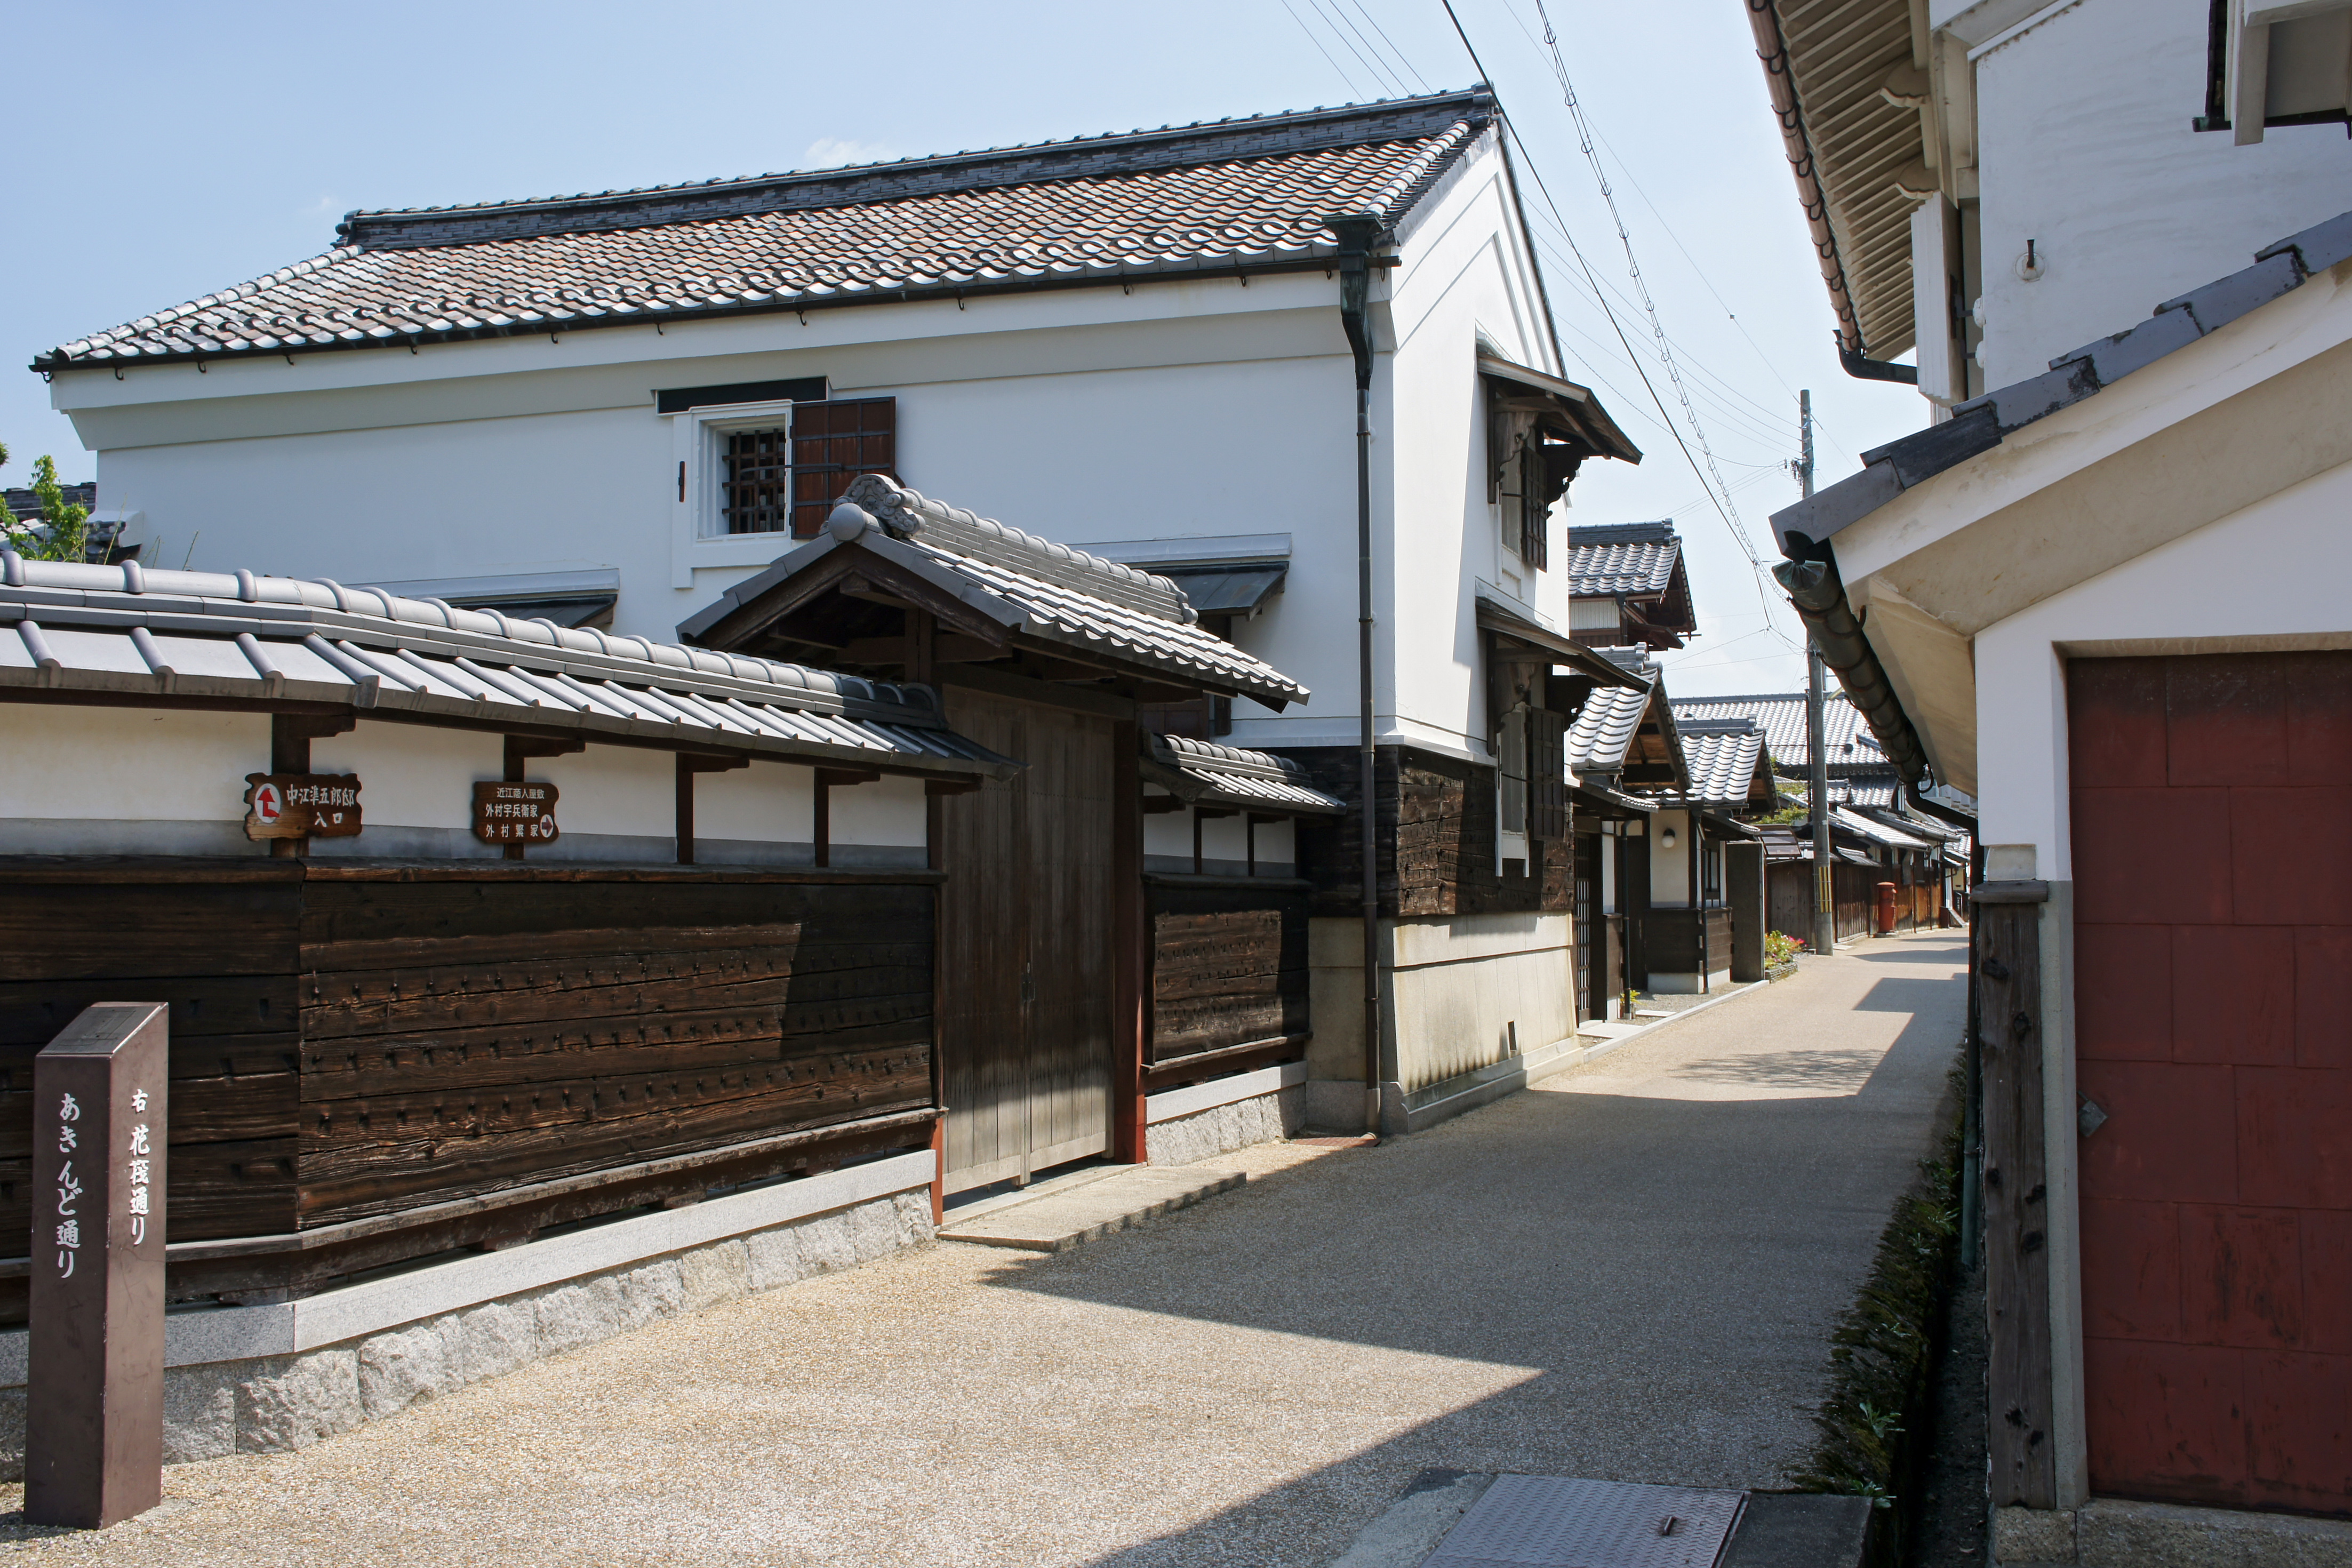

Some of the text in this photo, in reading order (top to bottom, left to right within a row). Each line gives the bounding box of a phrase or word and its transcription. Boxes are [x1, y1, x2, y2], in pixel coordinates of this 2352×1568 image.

[286, 783, 354, 807] 中江準五郎邸
[497, 787, 545, 799] 近江商人屋敷
[485, 803, 538, 818] 外村宇兵衛家
[315, 812, 343, 827] 入口
[486, 824, 538, 838] 外村繁家
[57, 1093, 83, 1279] あきんど通り
